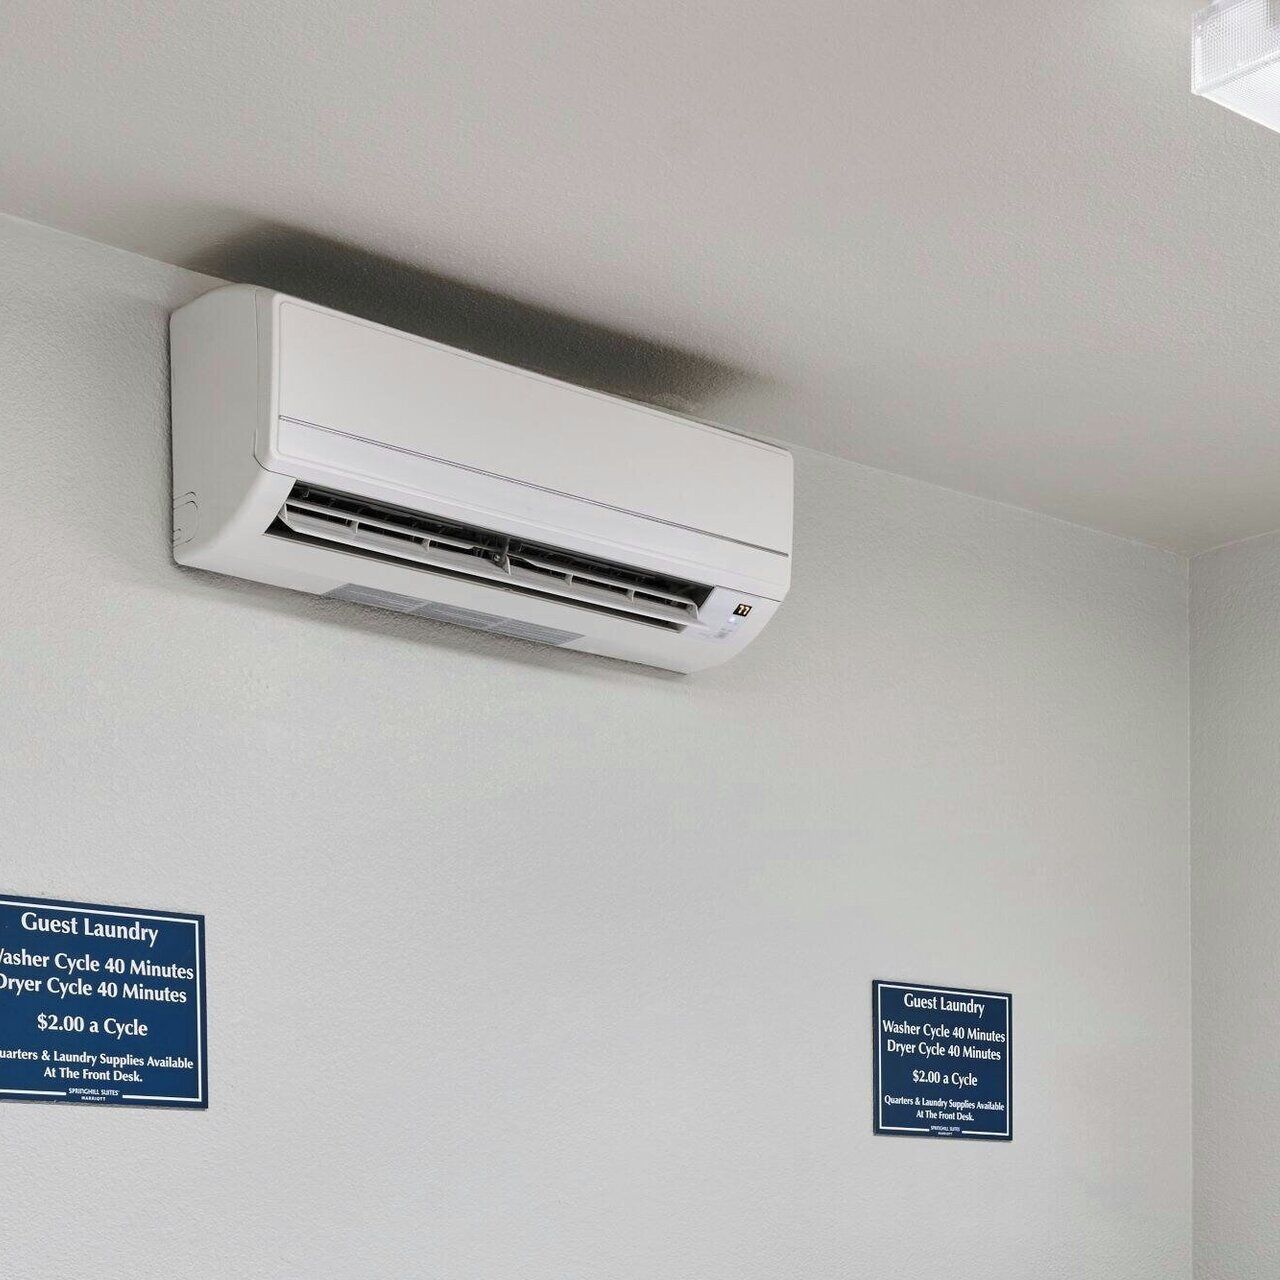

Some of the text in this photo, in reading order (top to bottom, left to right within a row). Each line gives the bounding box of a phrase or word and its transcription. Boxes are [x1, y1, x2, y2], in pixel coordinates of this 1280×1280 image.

[21, 912, 158, 948] Guest Laundry
[54, 953, 100, 974] Cycle
[104, 958, 125, 974] 40
[130, 959, 194, 980] Minutes
[47, 977, 92, 999] Cycle
[97, 981, 118, 997] 40
[122, 983, 187, 1003] Minutes
[904, 993, 985, 1018] Guest Laundry
[37, 1013, 148, 1039] $2.00 a Cycle
[883, 1020, 1005, 1043] Washer Cycle 40 Minutes
[41, 1050, 51, 1061] &
[53, 1050, 97, 1066] Laundry
[100, 1054, 144, 1068] Supplies
[147, 1056, 194, 1069] Available
[887, 1039, 1001, 1060] Dryer Cycle 40 Minutes
[43, 1068, 143, 1083] At The Front Desk.
[912, 1070, 978, 1088] $2.00 a Cycle
[884, 1095, 1005, 1111] Quarters & Laundry Supplies Available
[916, 1110, 974, 1121] At The Front Desk.
